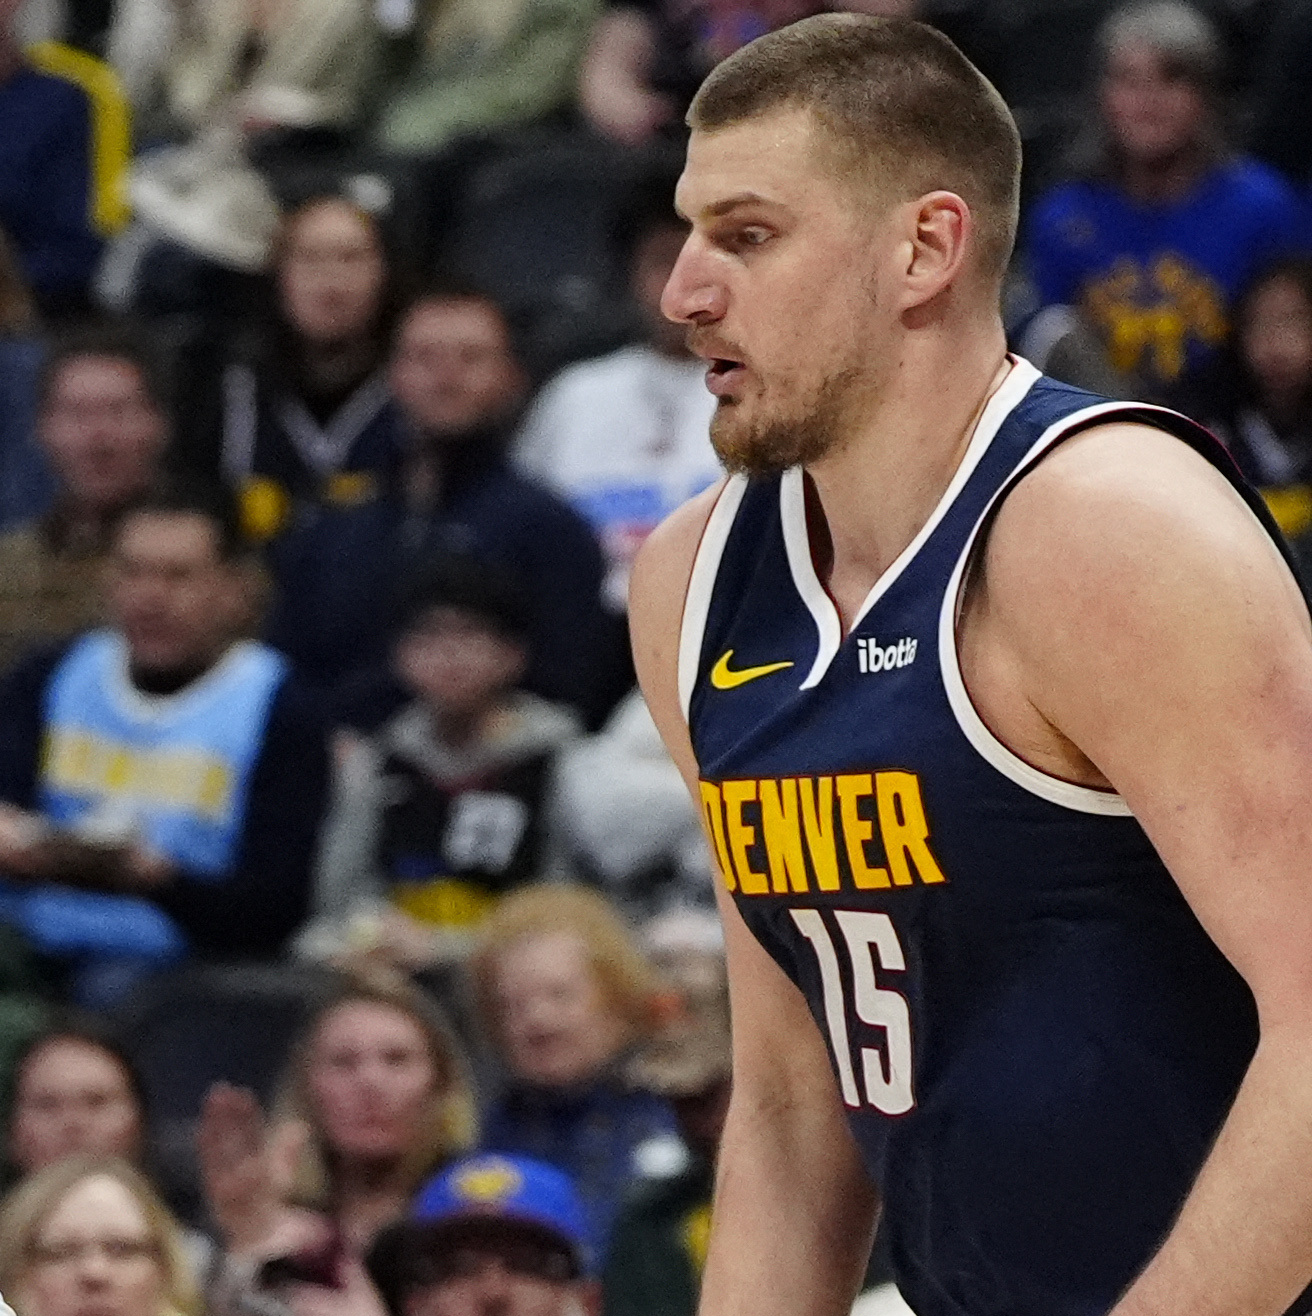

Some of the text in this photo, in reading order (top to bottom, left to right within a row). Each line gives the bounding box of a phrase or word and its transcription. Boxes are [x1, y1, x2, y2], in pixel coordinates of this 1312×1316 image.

[857, 636, 918, 674] ibotta
[699, 770, 947, 895] DENVER
[788, 907, 917, 1115] 15
